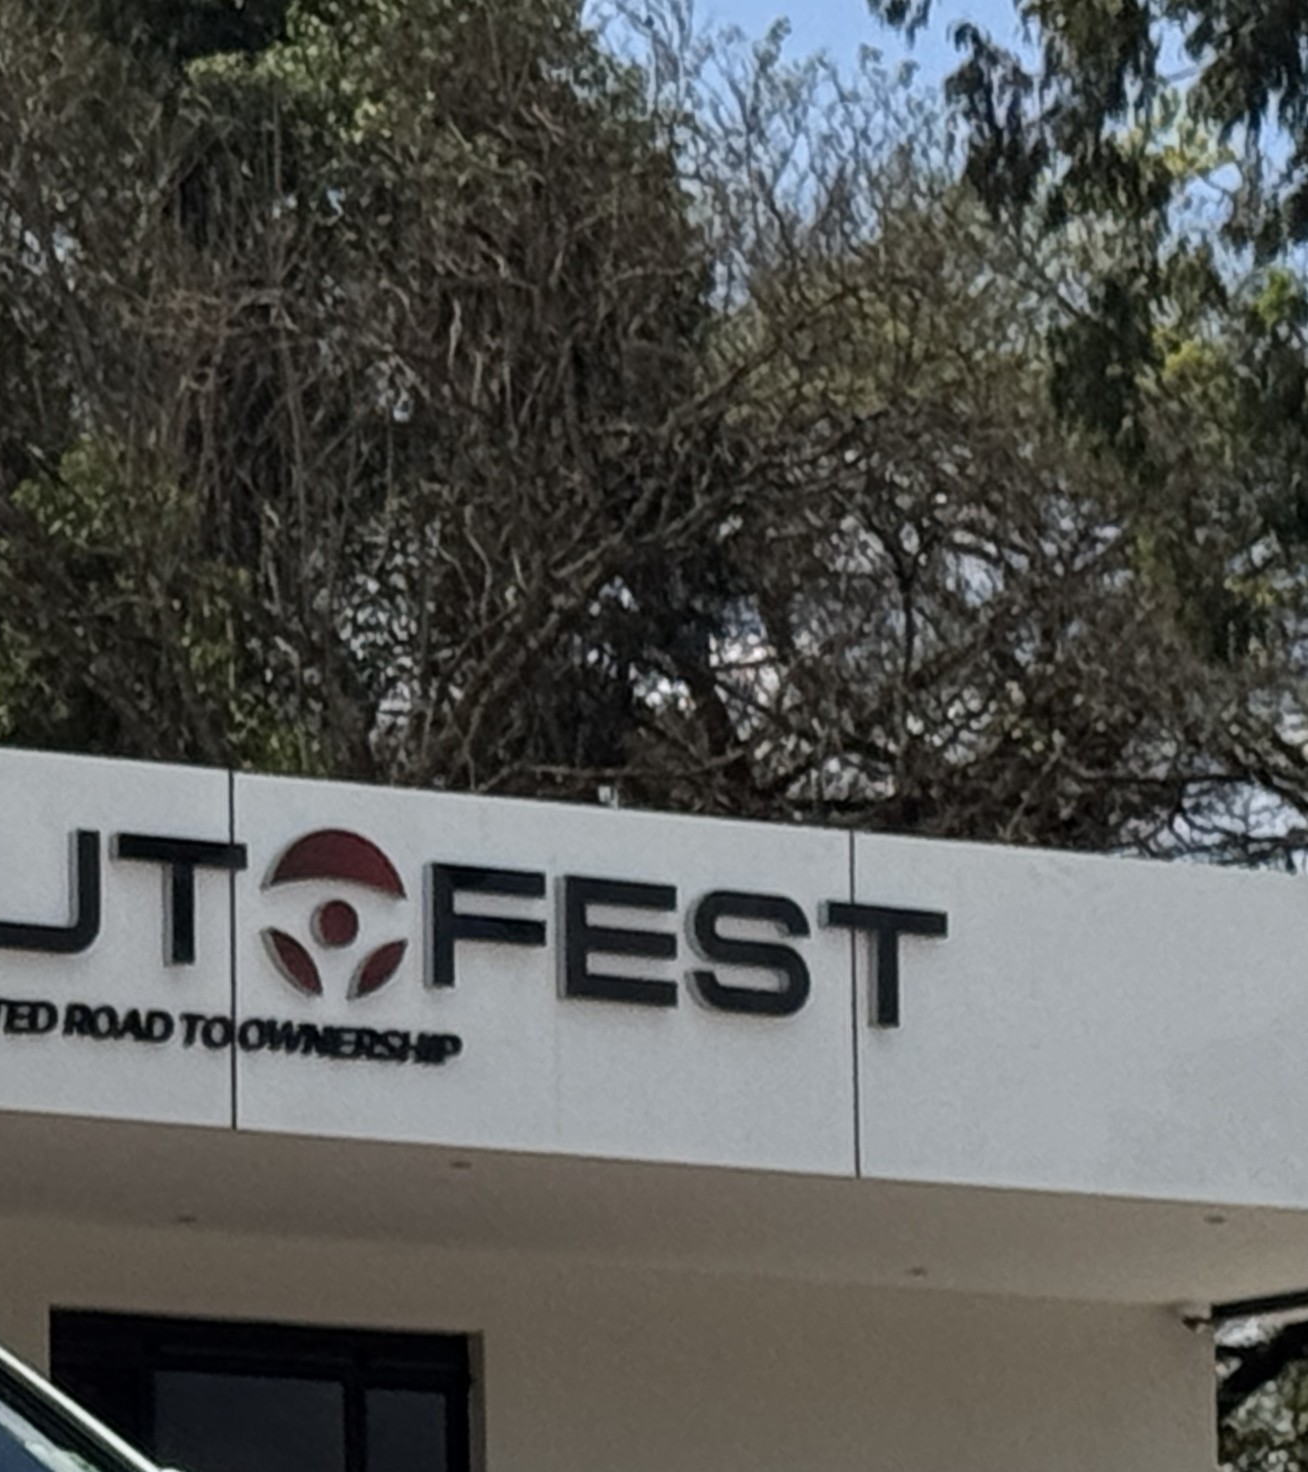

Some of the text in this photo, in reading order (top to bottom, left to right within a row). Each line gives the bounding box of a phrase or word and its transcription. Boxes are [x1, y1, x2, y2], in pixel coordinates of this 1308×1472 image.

[63, 1003, 175, 1044] ROAD
[179, 1011, 234, 1049] TO
[237, 1018, 463, 1066] OWNERSHIP
